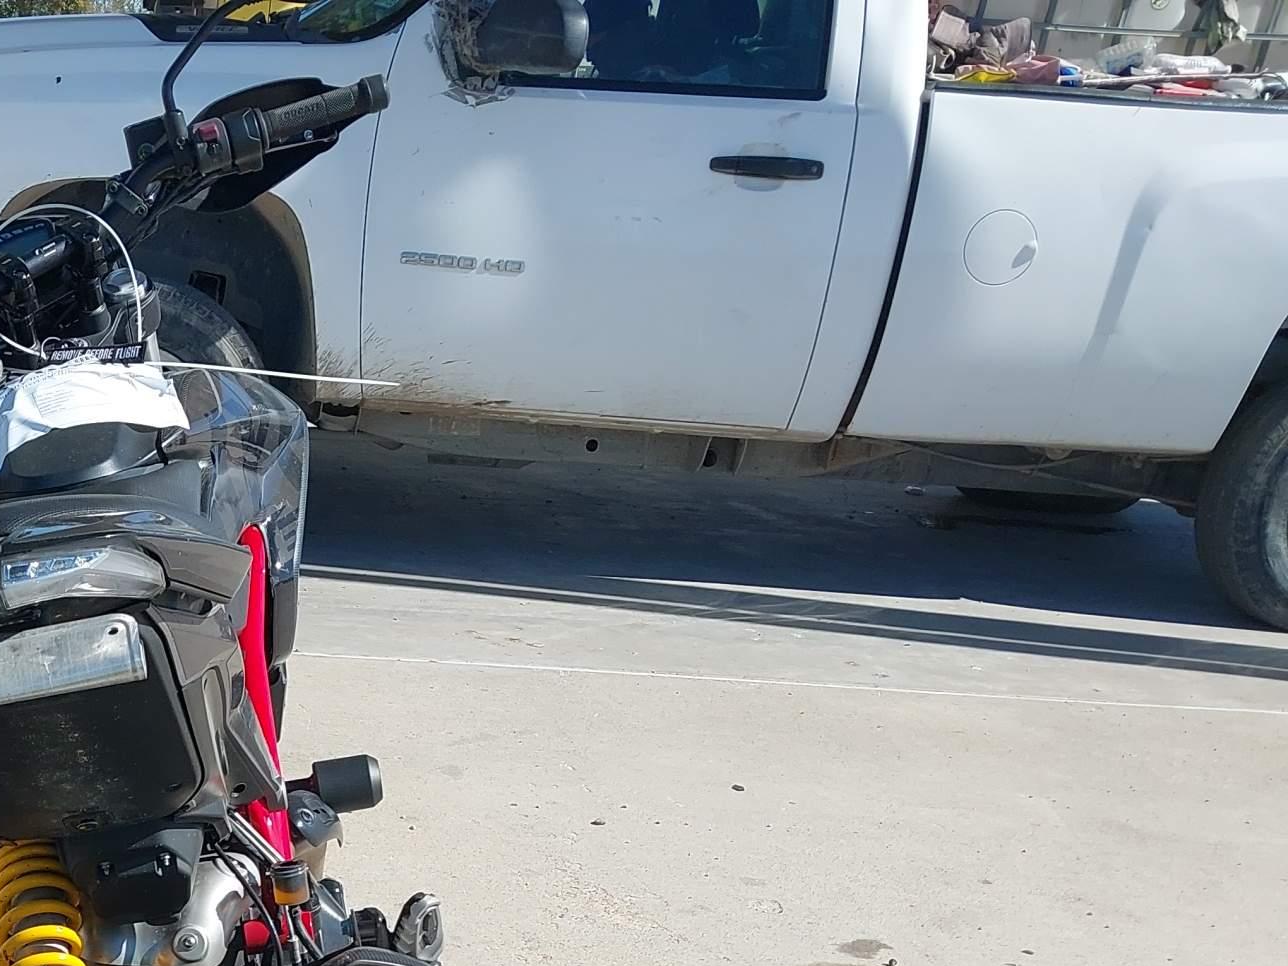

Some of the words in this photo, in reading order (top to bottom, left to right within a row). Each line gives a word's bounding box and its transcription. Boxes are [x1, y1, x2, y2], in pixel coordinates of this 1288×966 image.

[400, 250, 477, 270] 2500
[483, 258, 525, 274] HD
[115, 346, 142, 360] FLIGHT
